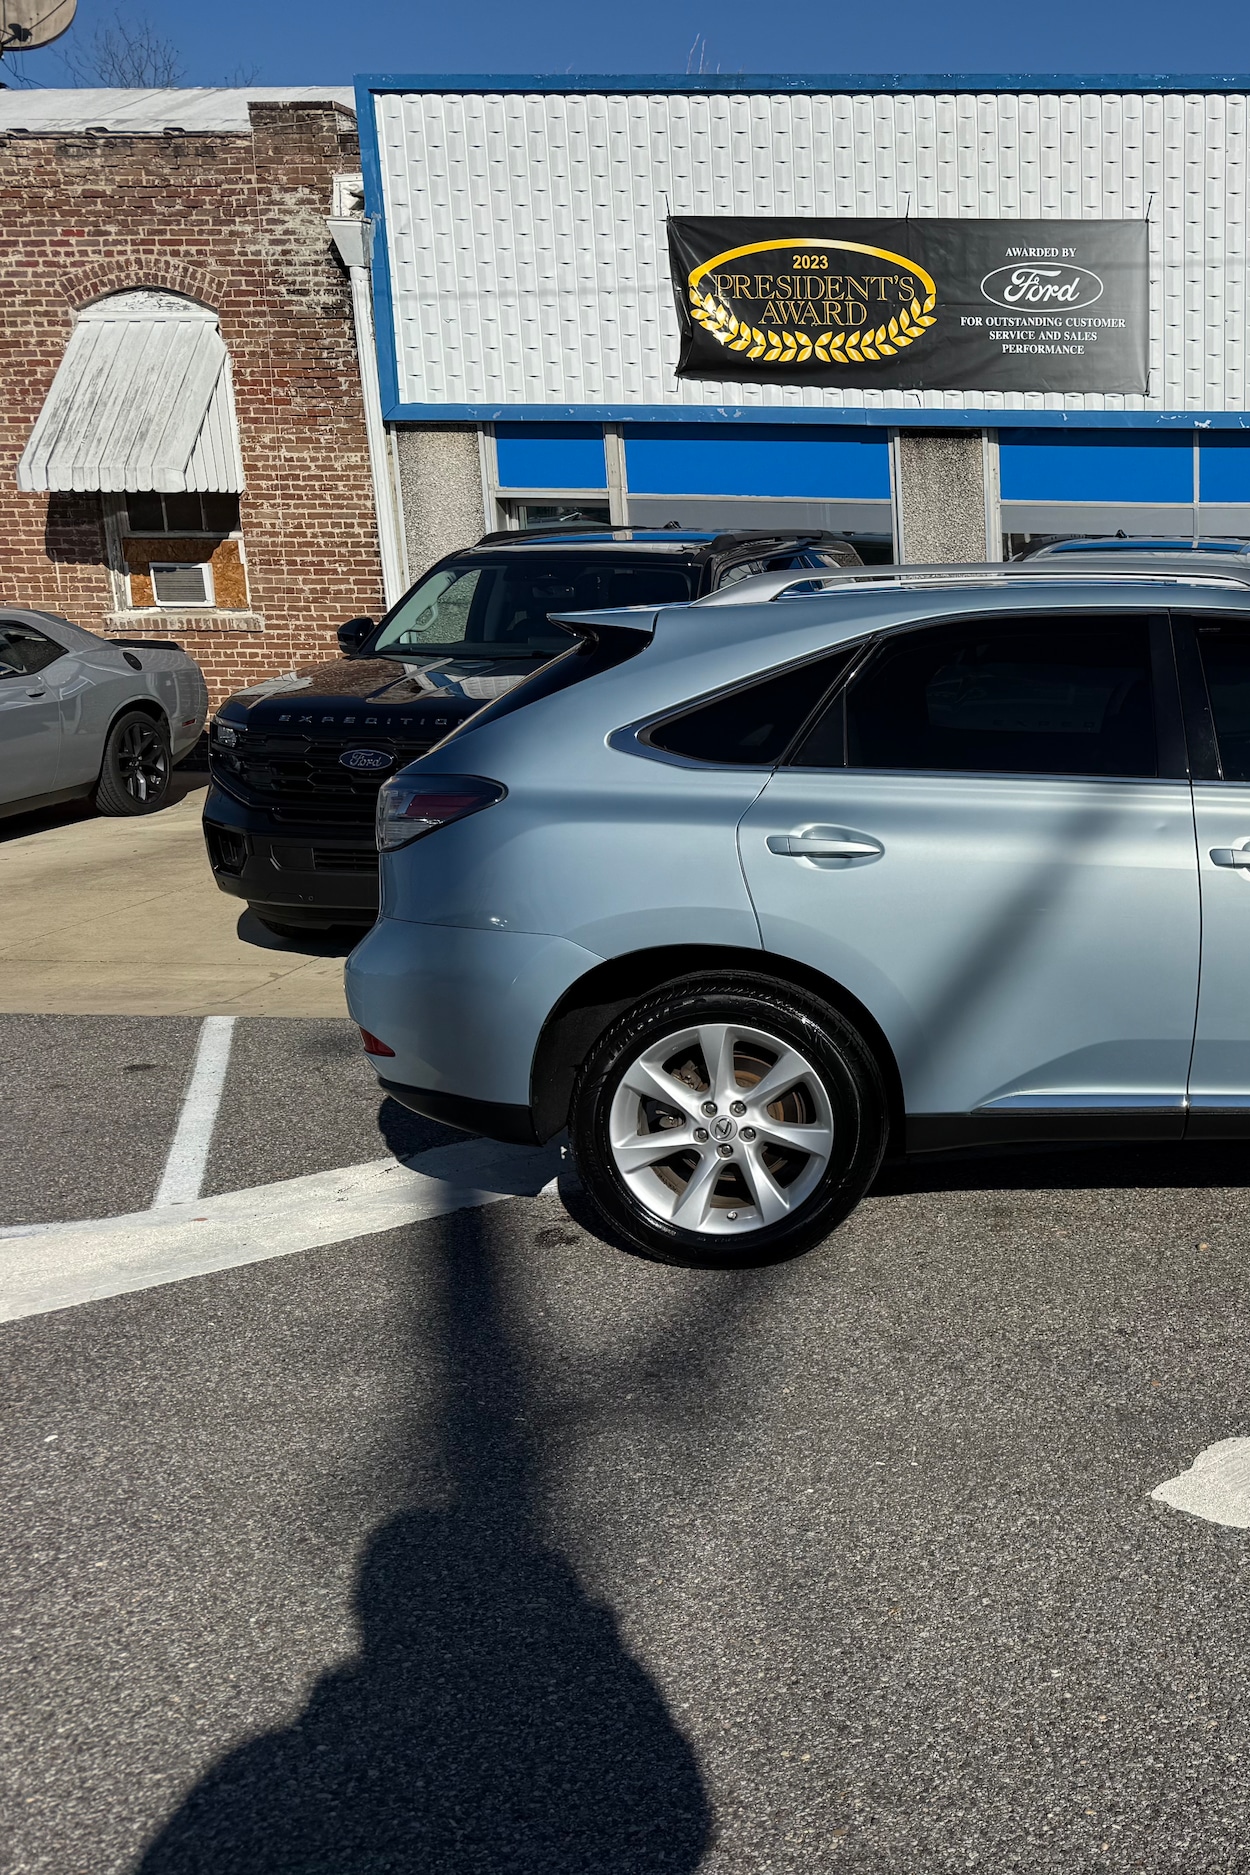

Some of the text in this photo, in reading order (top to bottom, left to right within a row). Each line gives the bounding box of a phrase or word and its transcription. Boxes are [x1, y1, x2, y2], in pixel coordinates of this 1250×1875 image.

[1005, 247, 1077, 258] AWARDED BY
[792, 255, 829, 270] 2023
[713, 274, 915, 301] PRESIDENT'S
[1003, 268, 1081, 302] Ford
[758, 300, 868, 326] AWARD
[960, 316, 1126, 328] FOR OUTSTANDING CUSTOMER
[989, 330, 1098, 341] SERVICE AND SALES
[1001, 344, 1085, 355] PERFORMANCE
[349, 752, 382, 767] Ford
